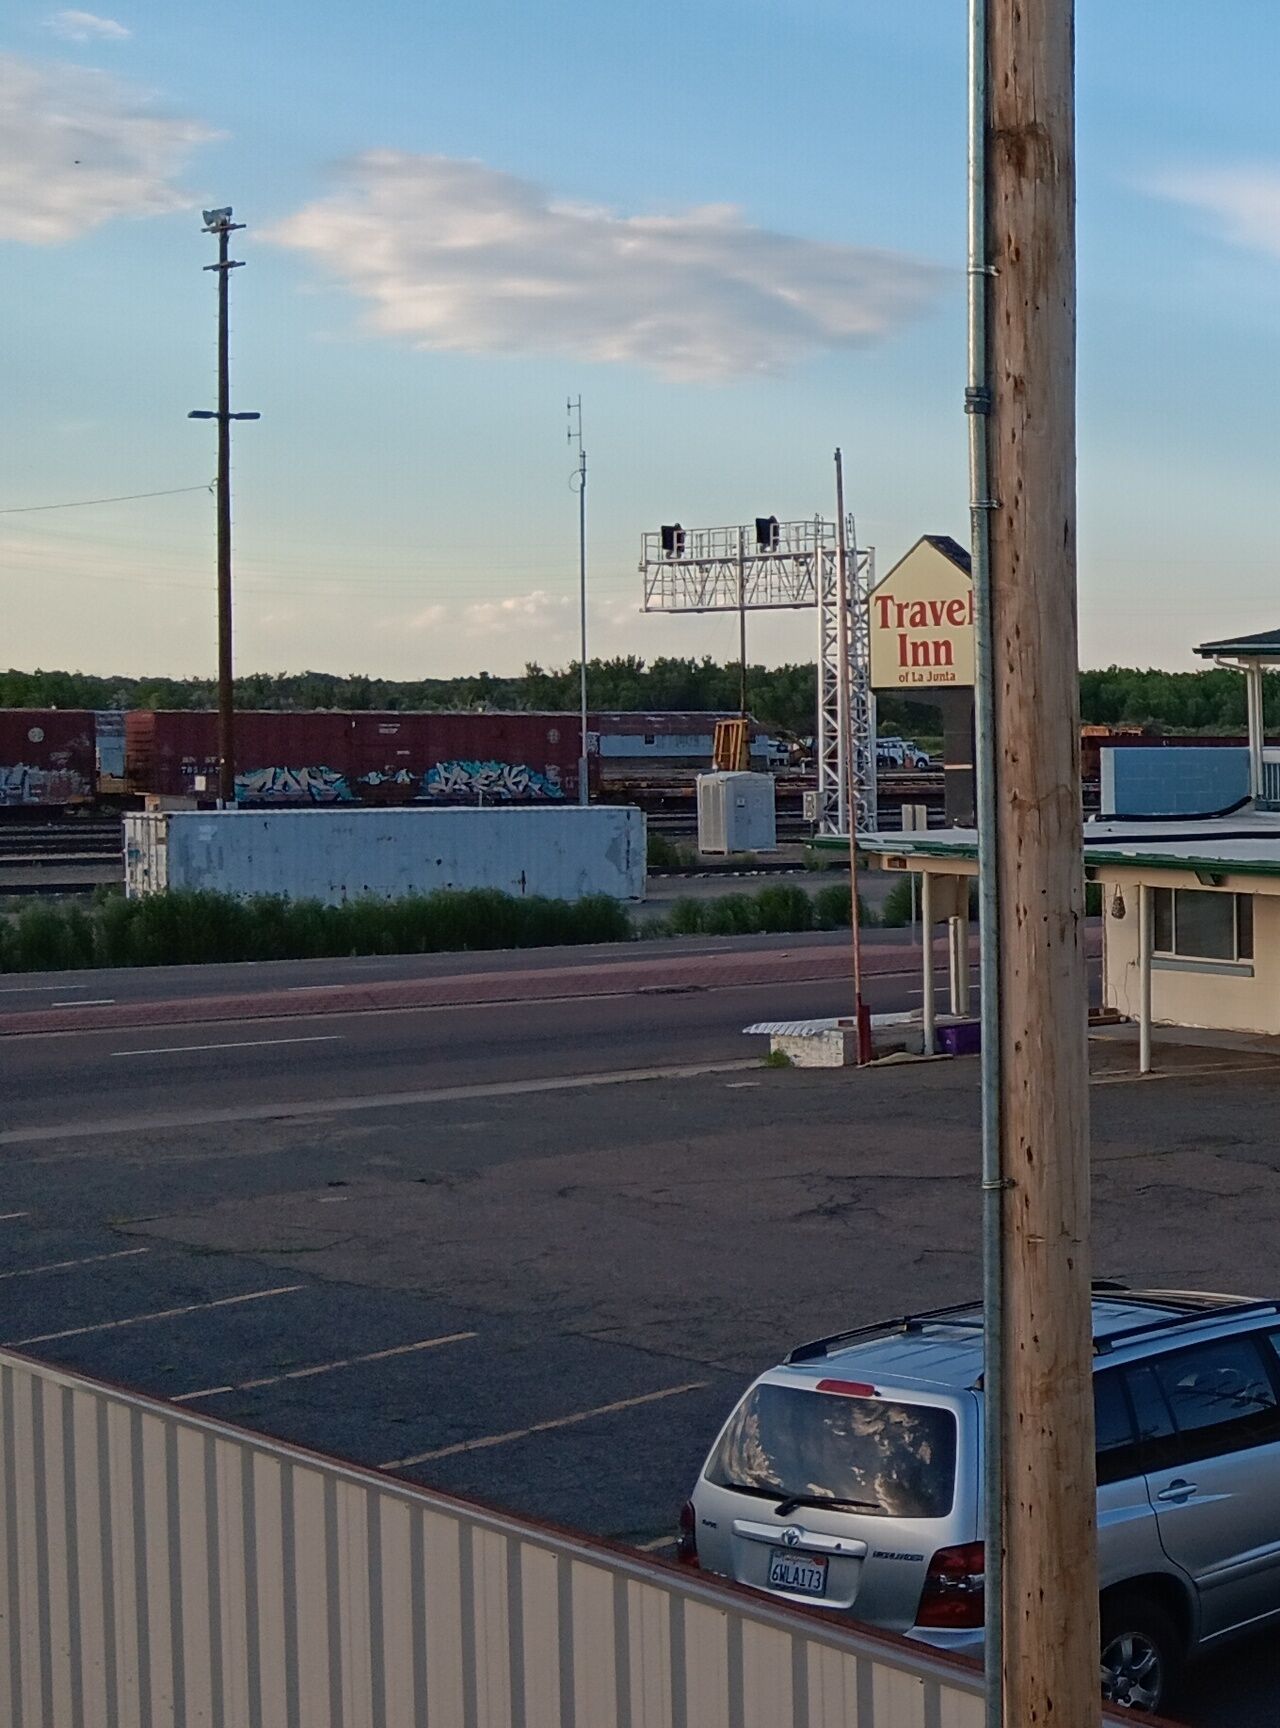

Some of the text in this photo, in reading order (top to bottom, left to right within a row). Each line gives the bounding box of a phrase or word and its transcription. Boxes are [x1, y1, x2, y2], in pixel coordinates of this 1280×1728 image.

[898, 634, 954, 668] Inn
[899, 671, 956, 683] of La Junta
[771, 1564, 822, 1589] 6WLA173
